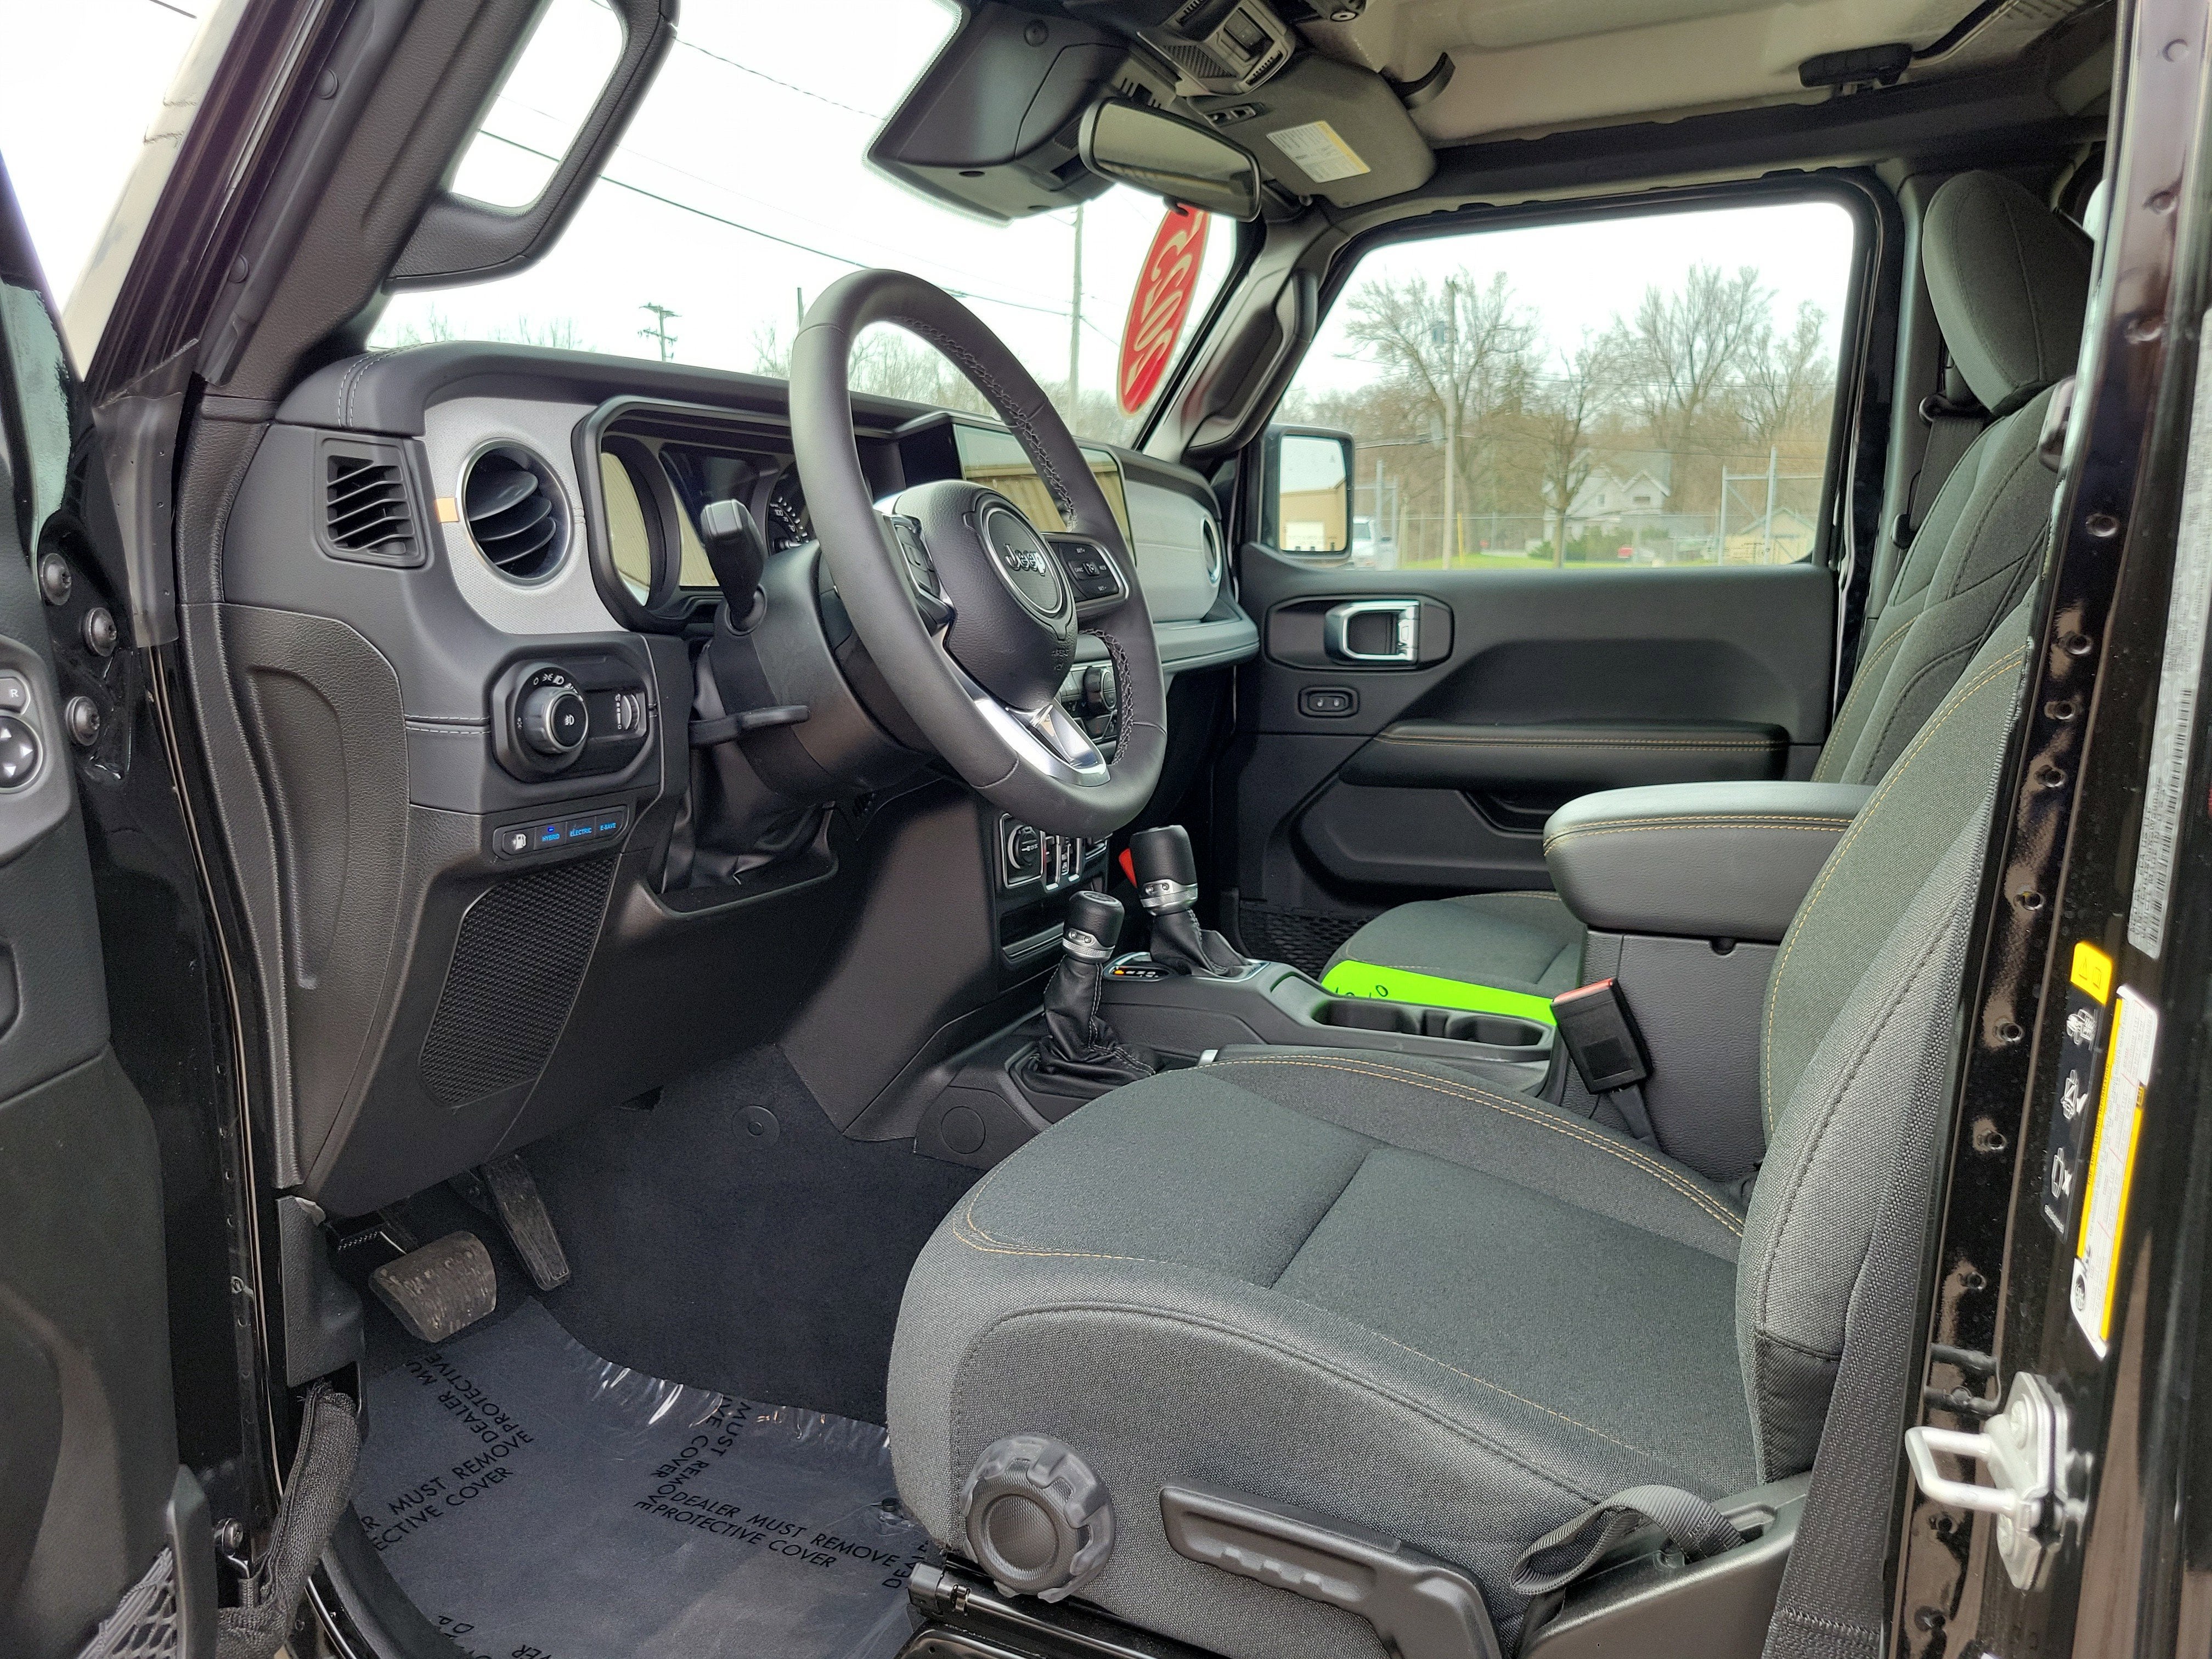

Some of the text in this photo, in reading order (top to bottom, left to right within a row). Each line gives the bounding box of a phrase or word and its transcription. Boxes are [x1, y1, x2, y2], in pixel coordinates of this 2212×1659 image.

[1003, 543, 1046, 577] Jeep
[10, 689, 19, 698] R
[425, 1353, 519, 1432] PROTECTIVE
[438, 1391, 499, 1443] DEALER
[710, 1402, 752, 1457] MUST
[388, 1430, 534, 1515] MUST REMOVE
[651, 1435, 709, 1478] COVER
[445, 1467, 514, 1506] COVER
[634, 1460, 710, 1510] REMOVE
[651, 1504, 837, 1568] PROTECTIVE COVER
[670, 1492, 900, 1567] DEALER MUST REMOVE
